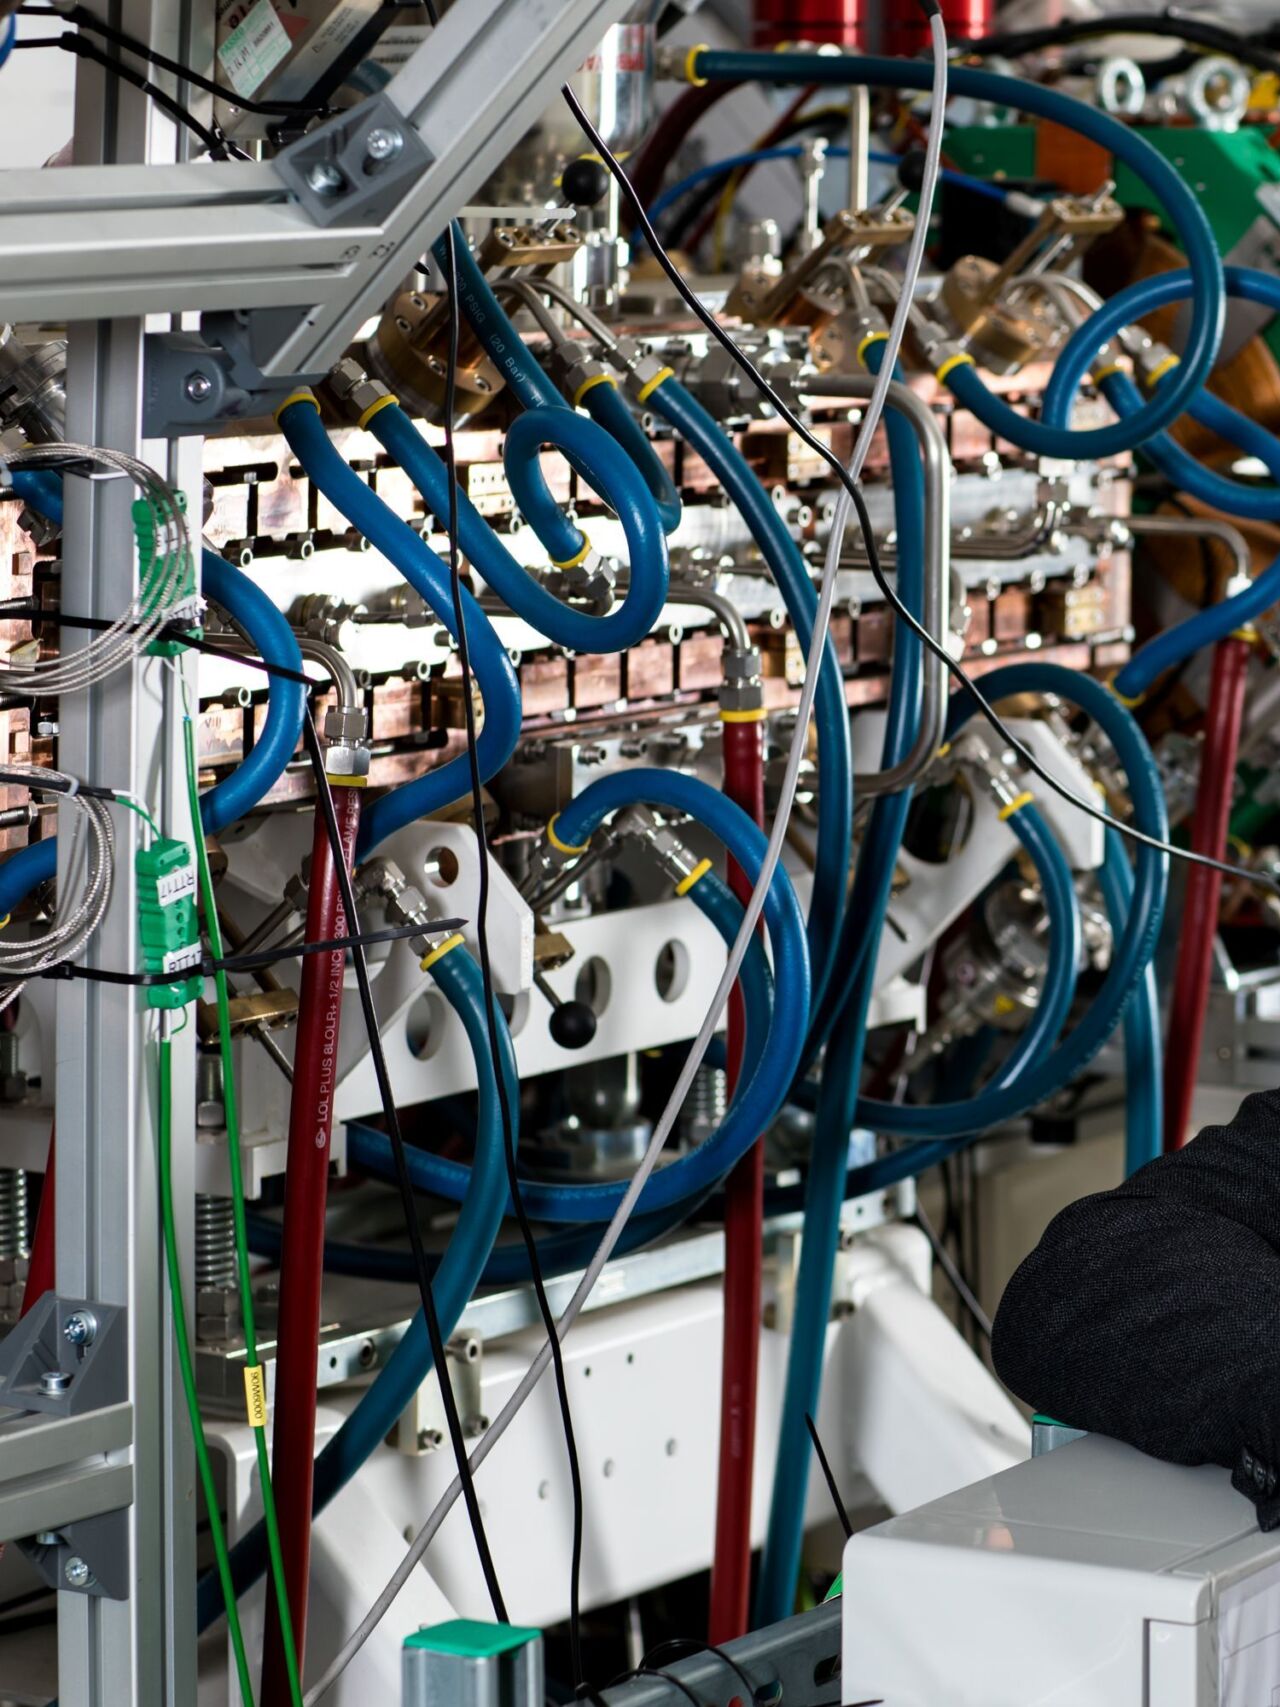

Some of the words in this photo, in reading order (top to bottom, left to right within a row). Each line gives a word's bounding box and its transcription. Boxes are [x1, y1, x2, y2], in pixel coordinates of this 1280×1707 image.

[488, 333, 506, 353] (20
[504, 356, 526, 383] Bar)
[160, 873, 194, 898] RTT17
[333, 916, 345, 938] 300
[328, 979, 340, 999] 1/2
[319, 1058, 333, 1093] PLUS
[316, 1095, 329, 1122] LOL
